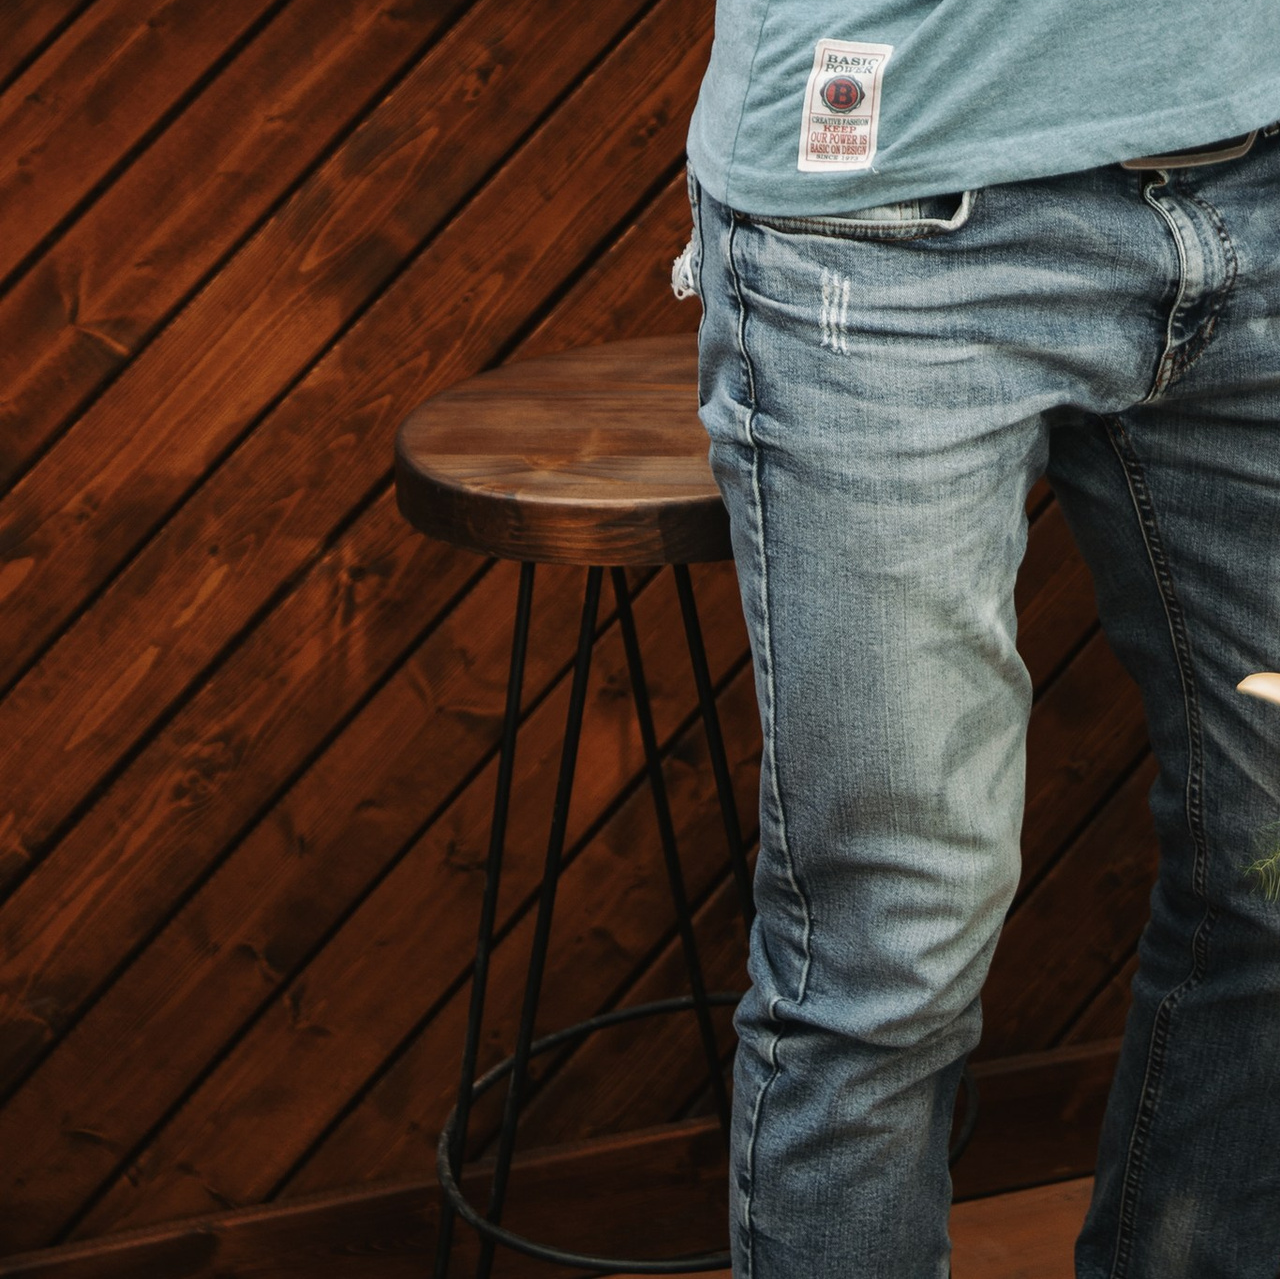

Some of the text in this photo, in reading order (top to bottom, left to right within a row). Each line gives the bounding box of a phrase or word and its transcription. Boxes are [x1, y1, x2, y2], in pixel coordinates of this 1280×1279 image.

[827, 54, 878, 66] BASIC
[825, 63, 874, 74] POWER
[833, 83, 852, 106] B
[811, 116, 869, 126] CREATIVE FASHION
[823, 124, 857, 133] KEEP
[811, 131, 867, 145] OUR POWER IS
[810, 143, 867, 155] BASIC ON DESIGN
